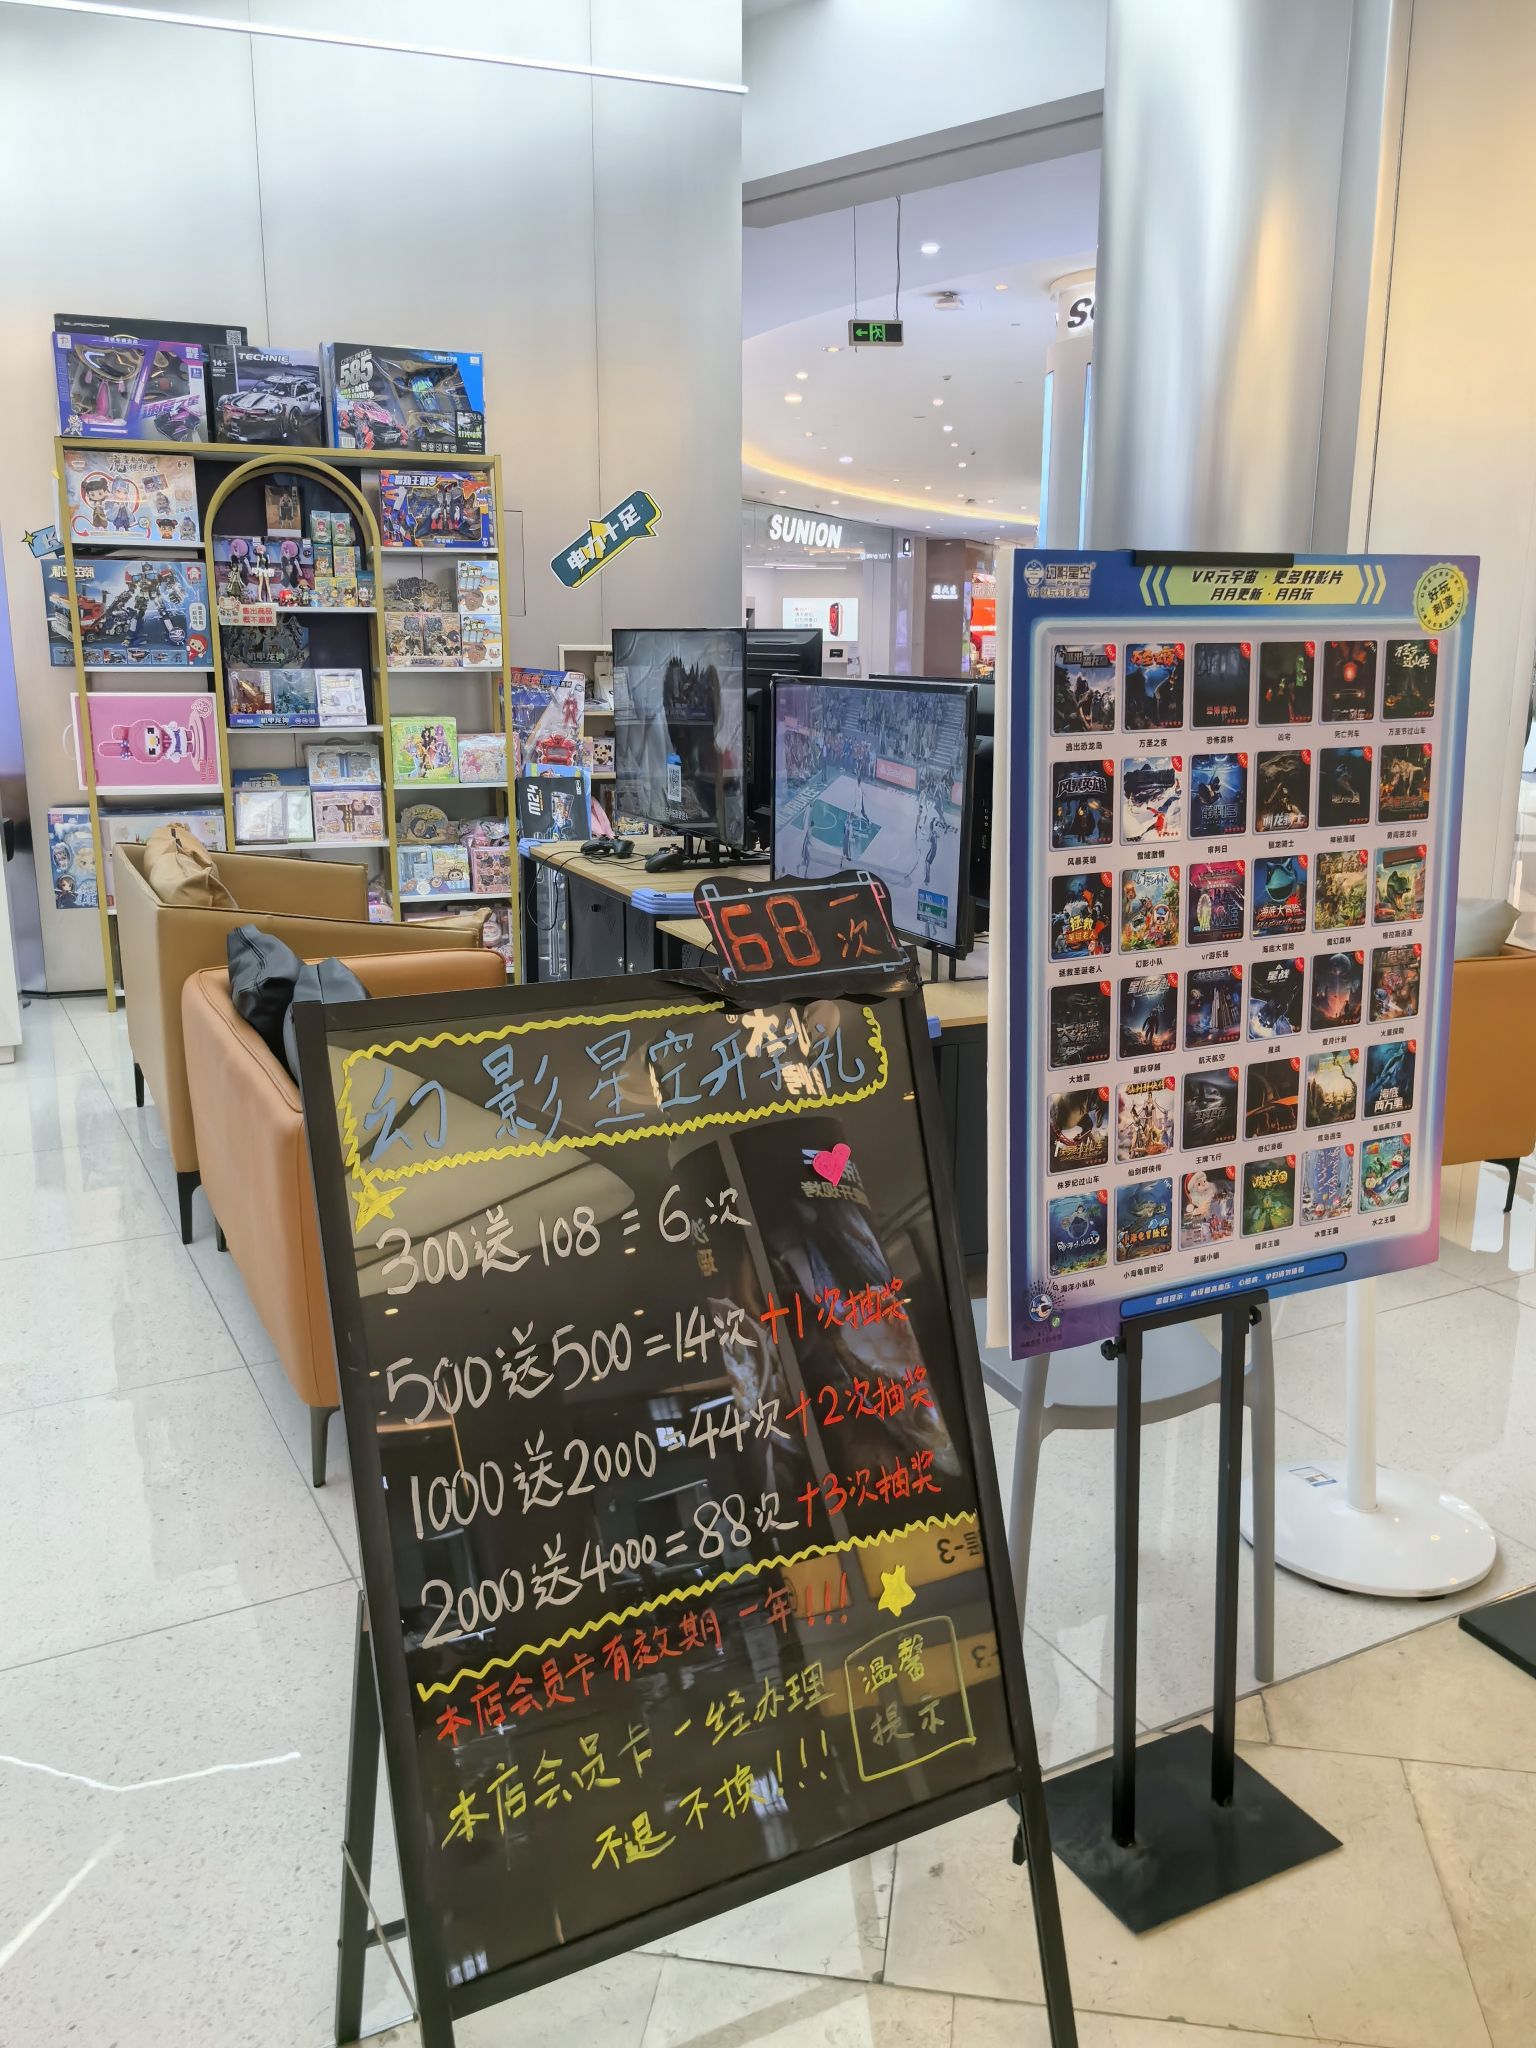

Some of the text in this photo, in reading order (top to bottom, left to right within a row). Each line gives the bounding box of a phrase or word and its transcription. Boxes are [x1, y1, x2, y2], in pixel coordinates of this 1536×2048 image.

[1067, 297, 1095, 328] S
[212, 359, 228, 368] 14+
[339, 355, 375, 389] 585
[176, 460, 189, 469] 6+
[566, 503, 641, 570] 电力十足
[769, 514, 843, 549] SUNION
[1045, 565, 1091, 580] 幻影星空
[1428, 580, 1451, 603] 好玩
[1432, 595, 1455, 617] 刺激
[1334, 729, 1360, 739] 死亡列车
[1388, 727, 1427, 737] 万圣节过山车
[1138, 738, 1168, 748] 万圣之夜
[1206, 735, 1234, 745] 恐怖森林
[1065, 741, 1103, 752] 逃出恐龙岛
[1056, 776, 1107, 798] 风暴英雄
[527, 784, 541, 816] M24
[1136, 850, 1166, 860] 雪域激情
[1207, 844, 1228, 854] 审判日
[1067, 855, 1097, 866] 风暴英雄
[1069, 915, 1094, 932] 拯救
[720, 894, 821, 972] 68
[1262, 943, 1295, 954] 海底大冒险
[1201, 950, 1229, 961] vr游乐场
[1135, 959, 1163, 969] 幻影小队
[1058, 965, 1103, 978] 拯救圣诞老人
[1266, 968, 1290, 982] 星战
[1322, 1036, 1347, 1046] 登月计划
[1268, 1045, 1281, 1054] 星战
[1198, 1053, 1226, 1065] 航天航空
[1133, 1063, 1161, 1075] 星际穿越
[1069, 1074, 1090, 1084] 大地震
[363, 1021, 865, 1163] 幻影星空开学礼
[1379, 1086, 1399, 1100] 海底
[1374, 1099, 1404, 1113] 两万里
[1195, 1153, 1222, 1165] 王牌飞行
[1127, 1165, 1162, 1177] 仙剑群侠传
[1057, 1175, 1100, 1190] 侏罗纪过山车
[1372, 1215, 1396, 1226] 水之王国
[1314, 1227, 1339, 1238] 冰雪王国
[1193, 1252, 1220, 1264] 圣诞小镇
[1123, 1264, 1164, 1279] 小海龟冒险记
[1060, 1279, 1096, 1293] 海洋小纵队
[858, 1631, 926, 1694] 温馨
[870, 1693, 946, 1747] 提示
